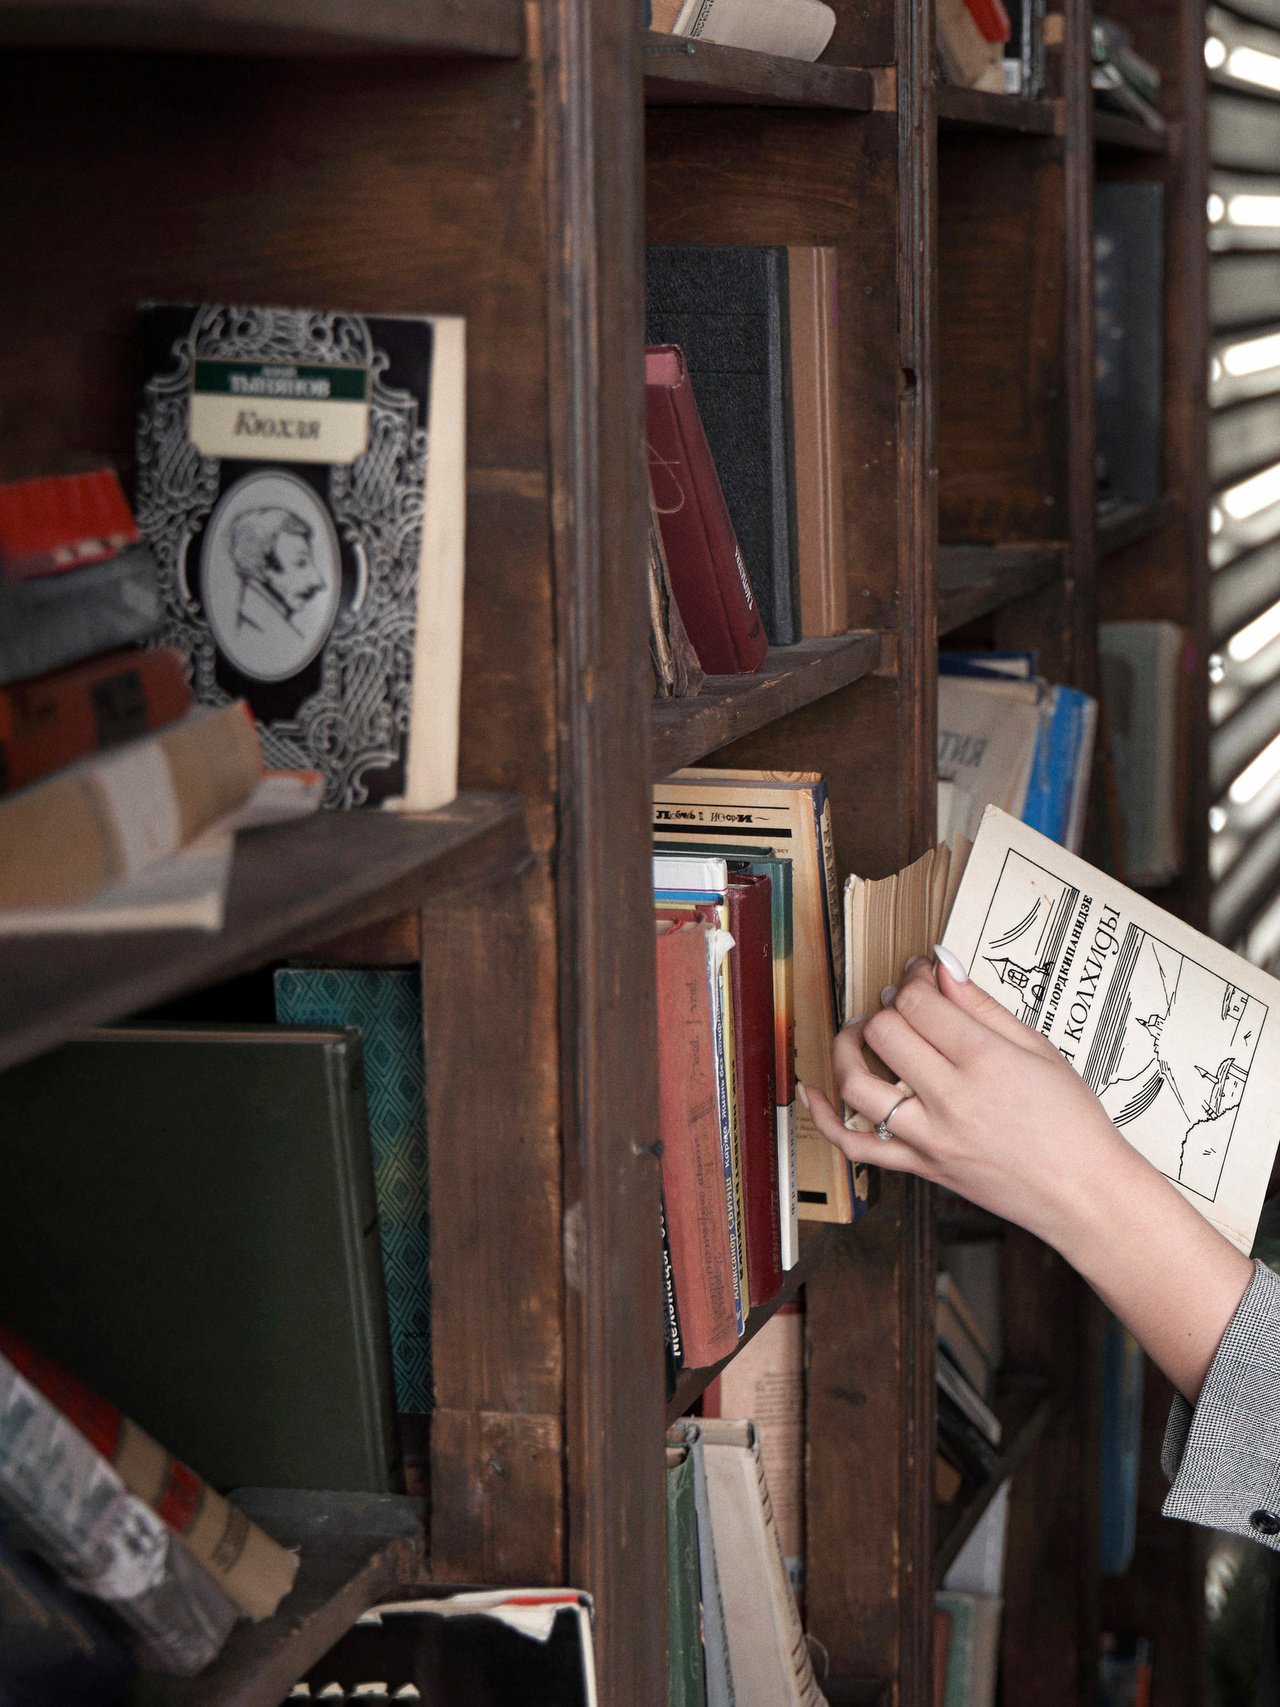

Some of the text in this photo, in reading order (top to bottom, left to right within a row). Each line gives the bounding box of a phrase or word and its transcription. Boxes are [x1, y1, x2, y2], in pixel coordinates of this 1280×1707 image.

[1048, 895, 1093, 1015] ЛОРДКИПАНИДЗЕ
[1064, 904, 1121, 1044] КОЛХИДЫ
[729, 1232, 740, 1300] Александр
